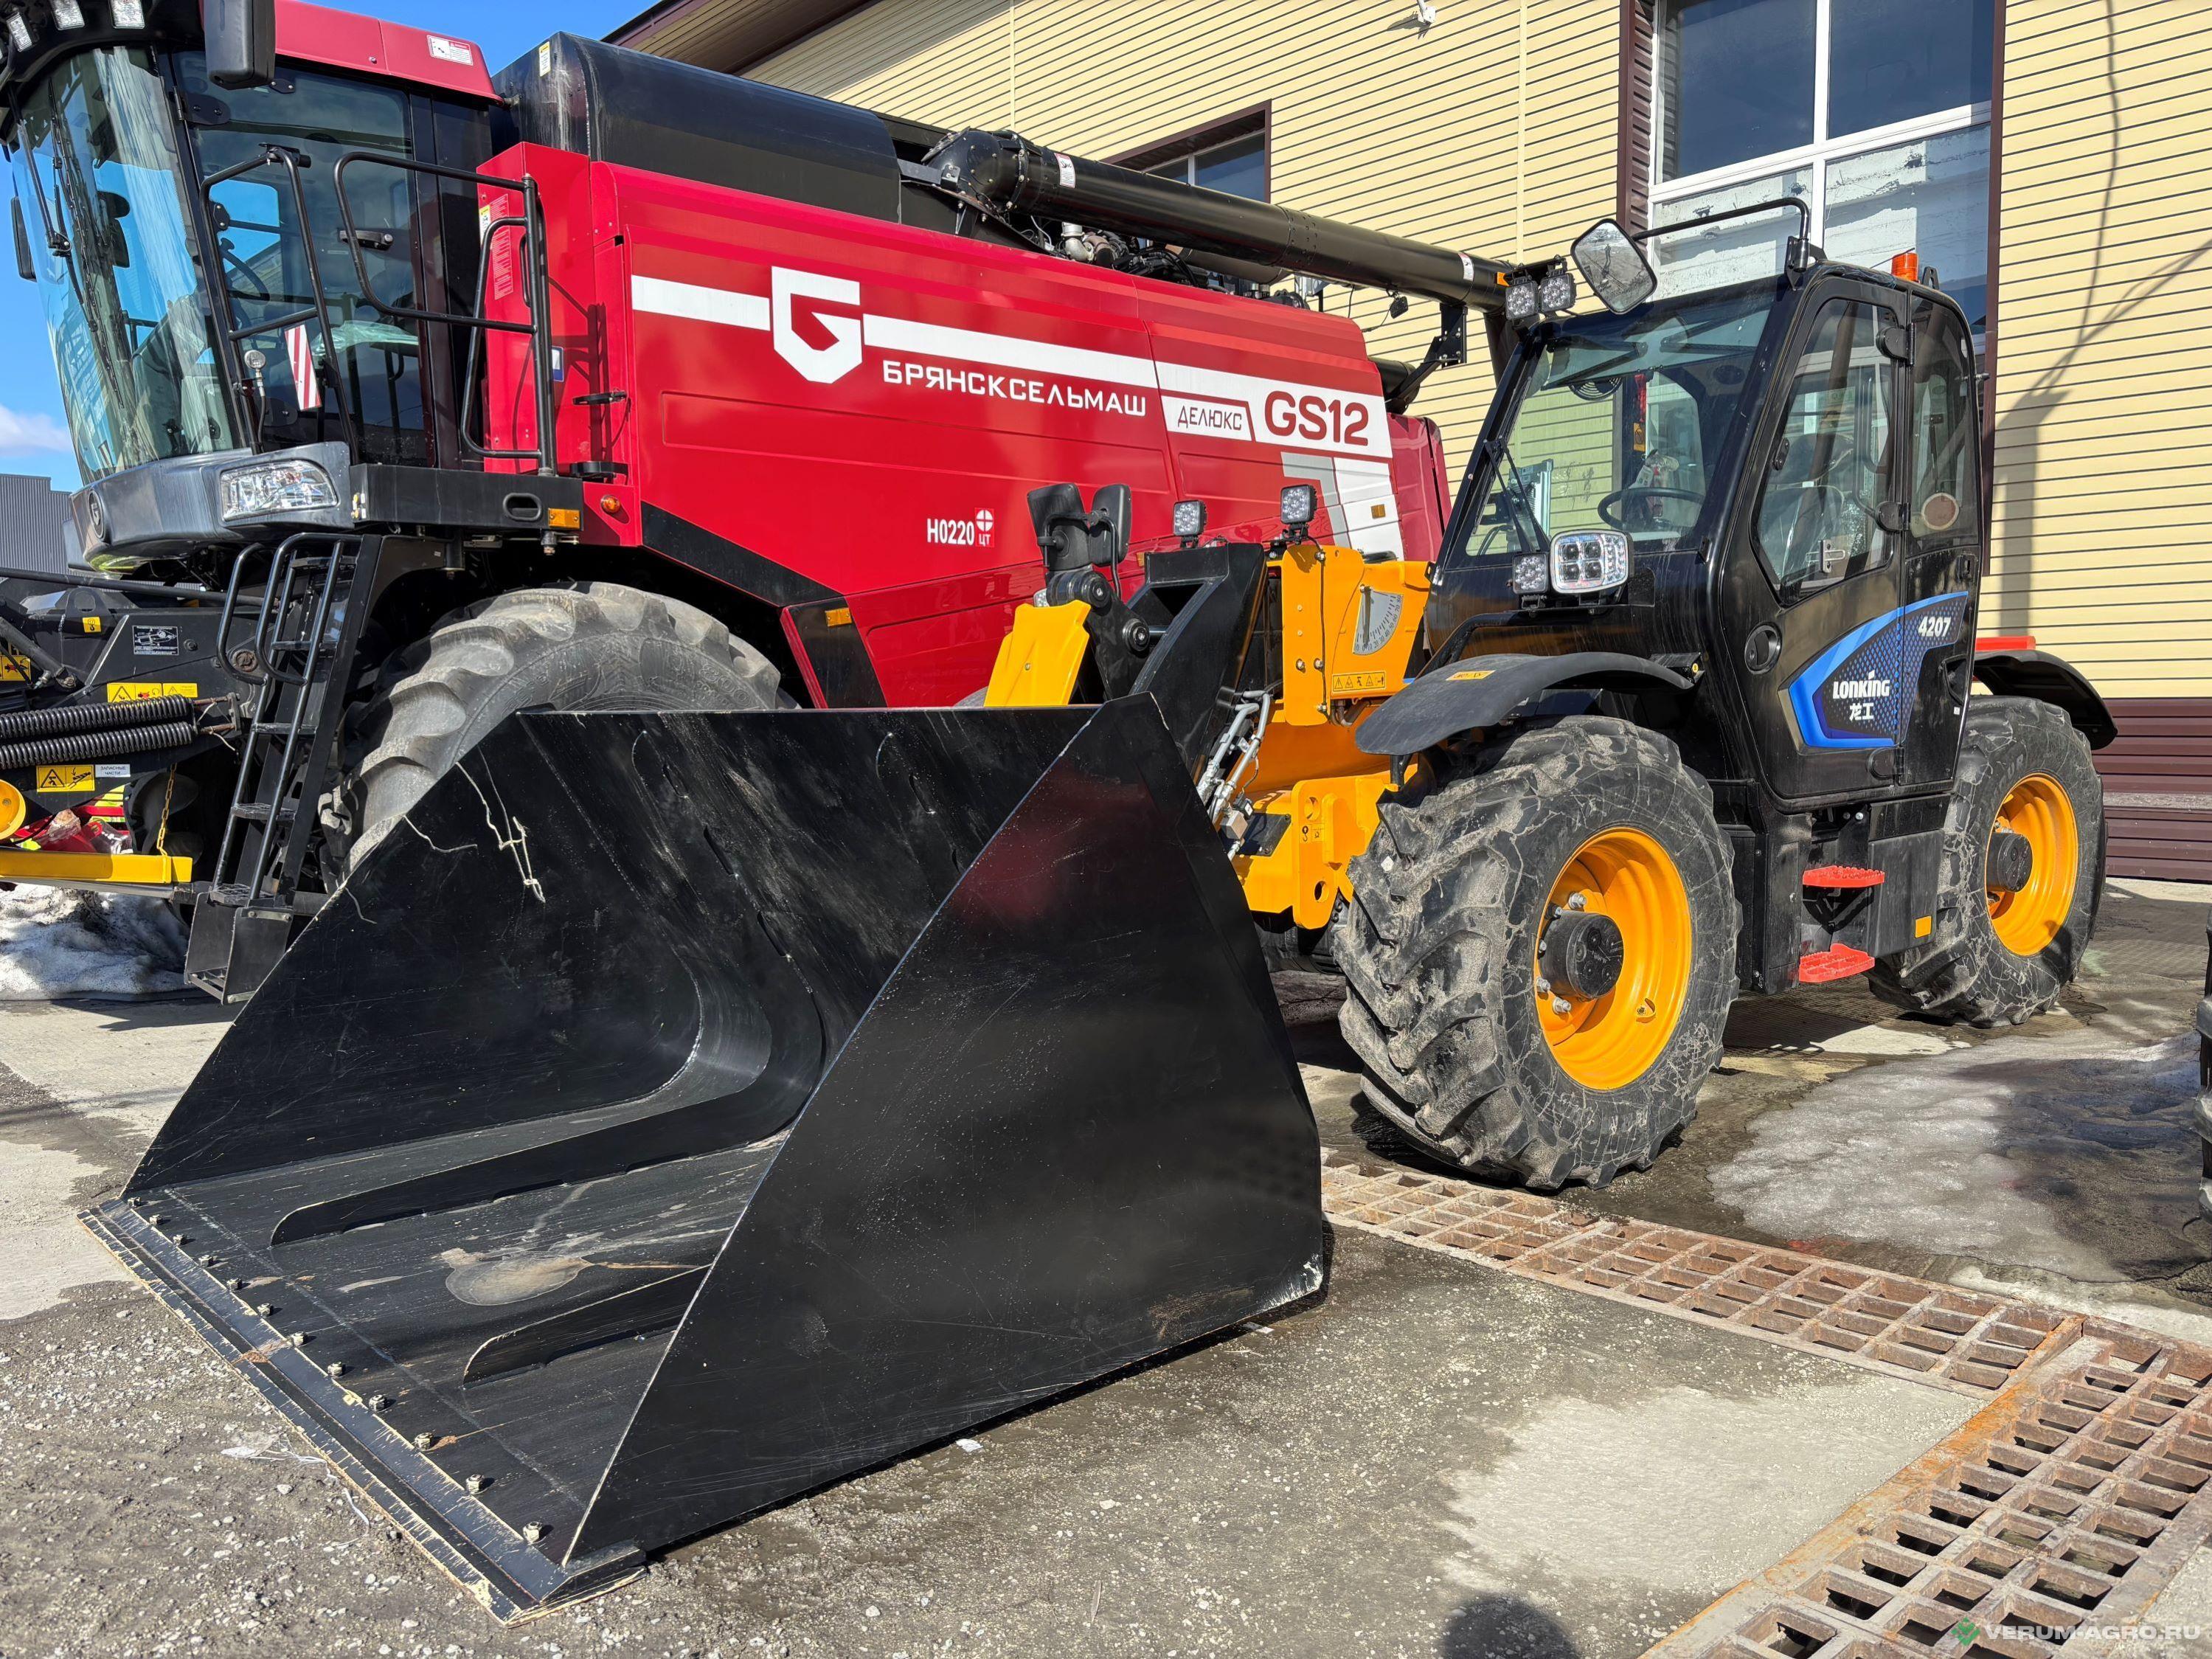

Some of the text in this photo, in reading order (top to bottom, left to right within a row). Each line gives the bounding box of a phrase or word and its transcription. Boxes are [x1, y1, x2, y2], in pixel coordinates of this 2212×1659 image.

[882, 359, 1146, 416] БРЯНСКСЕЛЬМАШ
[1177, 405, 1242, 431] ДЕЛЮКС
[1264, 390, 1369, 446] GS12
[978, 533, 991, 547] ЦТ
[1918, 616, 1952, 637] 4207
[1848, 702, 1874, 721] 龙工
